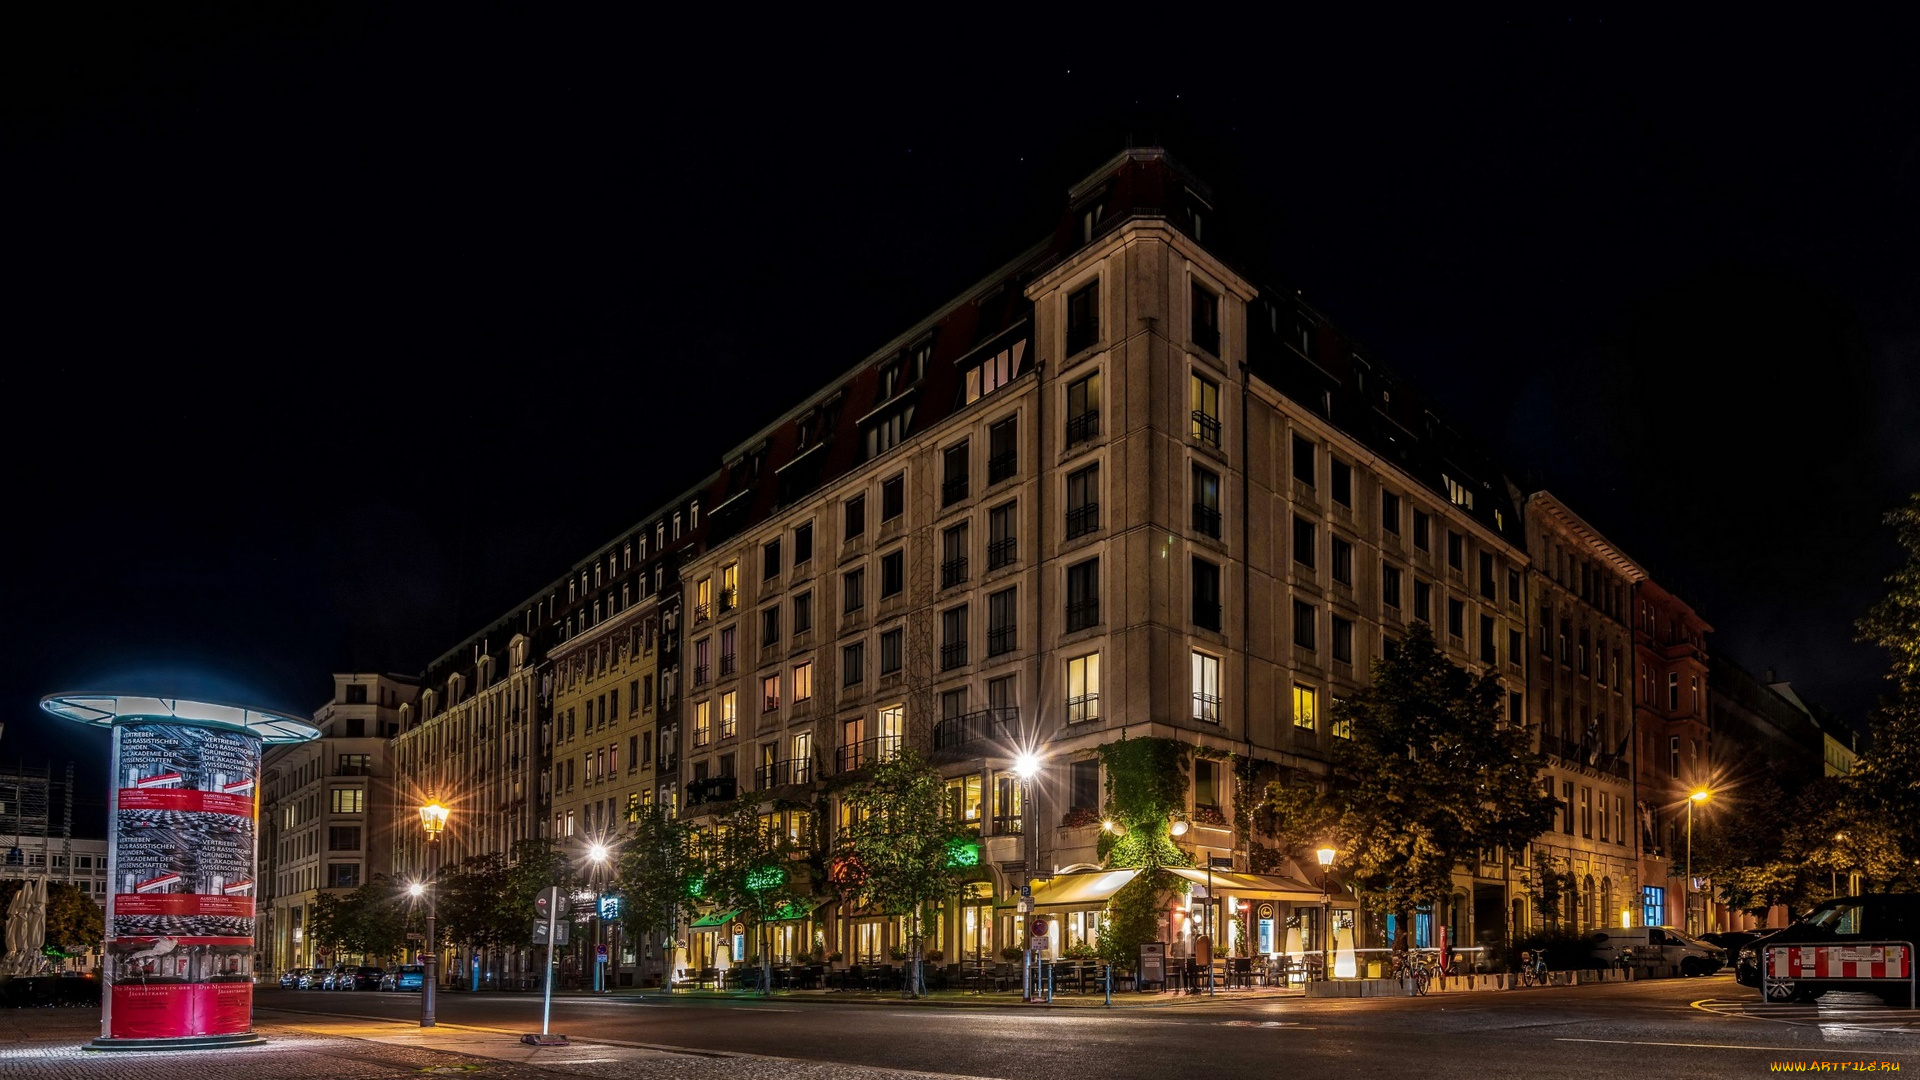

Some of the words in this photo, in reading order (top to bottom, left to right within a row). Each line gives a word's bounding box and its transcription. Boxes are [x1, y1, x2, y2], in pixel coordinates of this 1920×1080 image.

[204, 736, 240, 746] VERTRIEBEN
[219, 744, 254, 755] RASSISTISCHEN
[216, 756, 245, 766] AKADEMIE
[204, 761, 250, 772] WISSENSCHAFTEN
[202, 839, 238, 847] VERTRIEBEN
[216, 846, 251, 855] RASSISTISCHEN
[213, 858, 242, 866] AKADEMIE
[201, 864, 249, 872] WISSENSCHAFTEN
